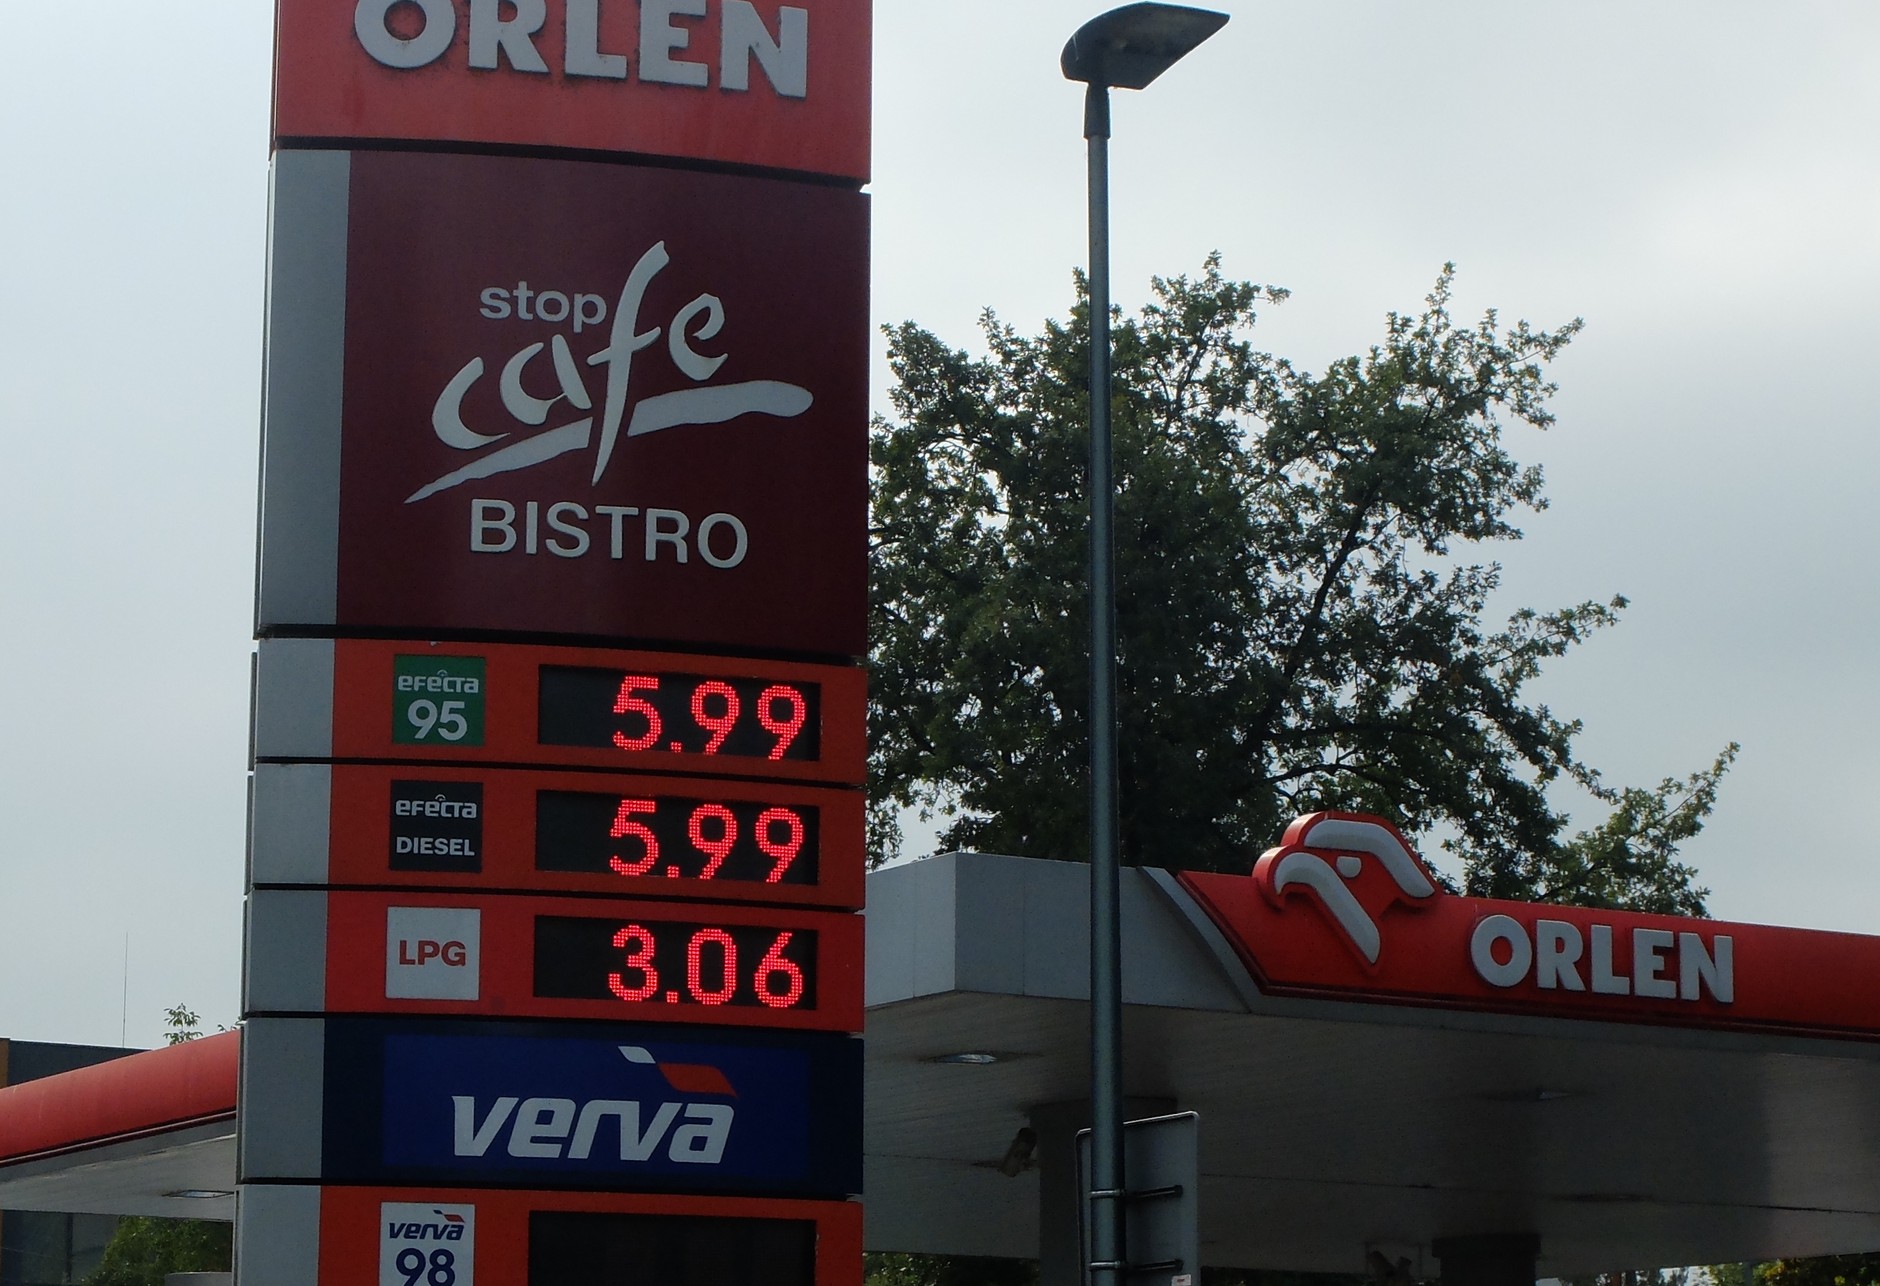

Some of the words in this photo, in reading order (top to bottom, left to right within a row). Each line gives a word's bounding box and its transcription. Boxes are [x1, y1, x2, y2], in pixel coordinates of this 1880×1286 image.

[354, 0, 808, 98] ORLEN
[480, 281, 608, 332] stop
[432, 240, 728, 486] cafe
[470, 498, 748, 568] BISTRO
[407, 699, 468, 741] 95
[612, 675, 807, 761] 5.99
[396, 836, 475, 856] DIESEL
[608, 799, 805, 884] 5.99
[398, 941, 467, 967] LPG
[607, 924, 804, 1010] 3.06
[1470, 913, 1735, 1004] ORLEN
[451, 1095, 735, 1165] verva
[389, 1222, 465, 1241] verva
[395, 1247, 456, 1286] 98
